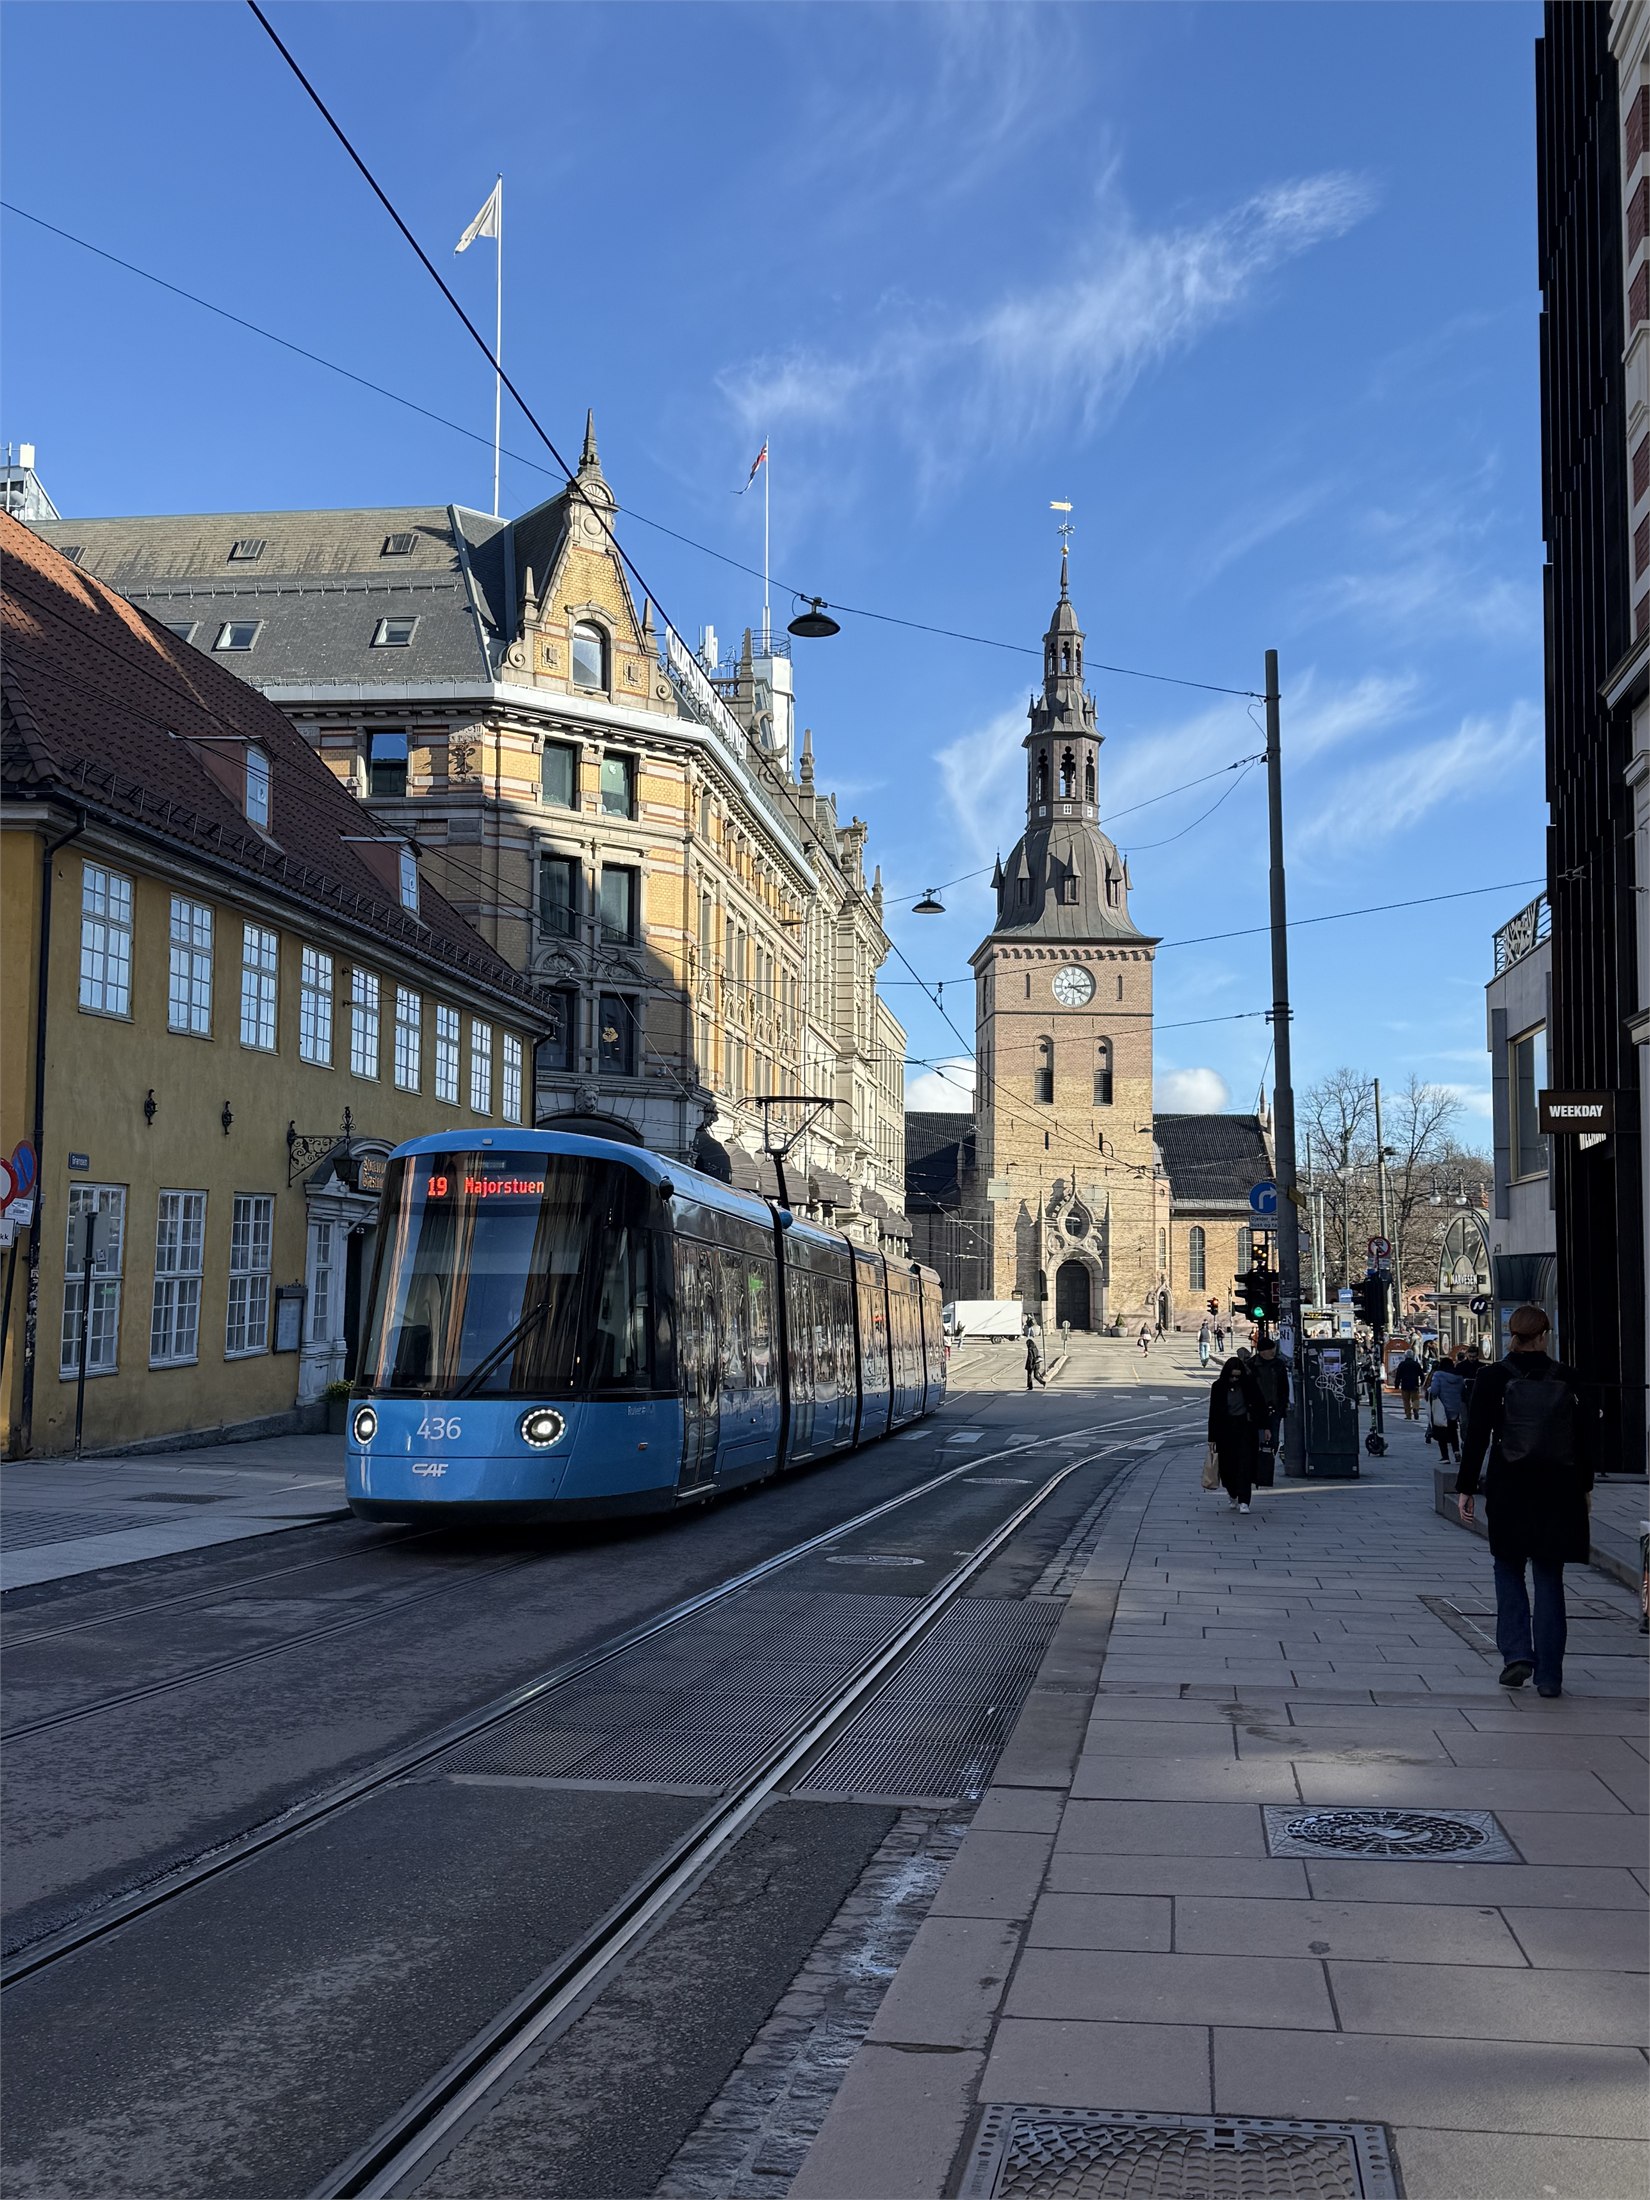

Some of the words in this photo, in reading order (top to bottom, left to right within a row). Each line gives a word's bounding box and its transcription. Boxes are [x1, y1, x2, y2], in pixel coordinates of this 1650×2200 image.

[1549, 1105, 1603, 1117] WEEKDAY
[428, 1177, 448, 1196] 19
[464, 1177, 544, 1197] Majorstuen
[416, 1416, 462, 1440] 436
[412, 1463, 449, 1477] CAF
